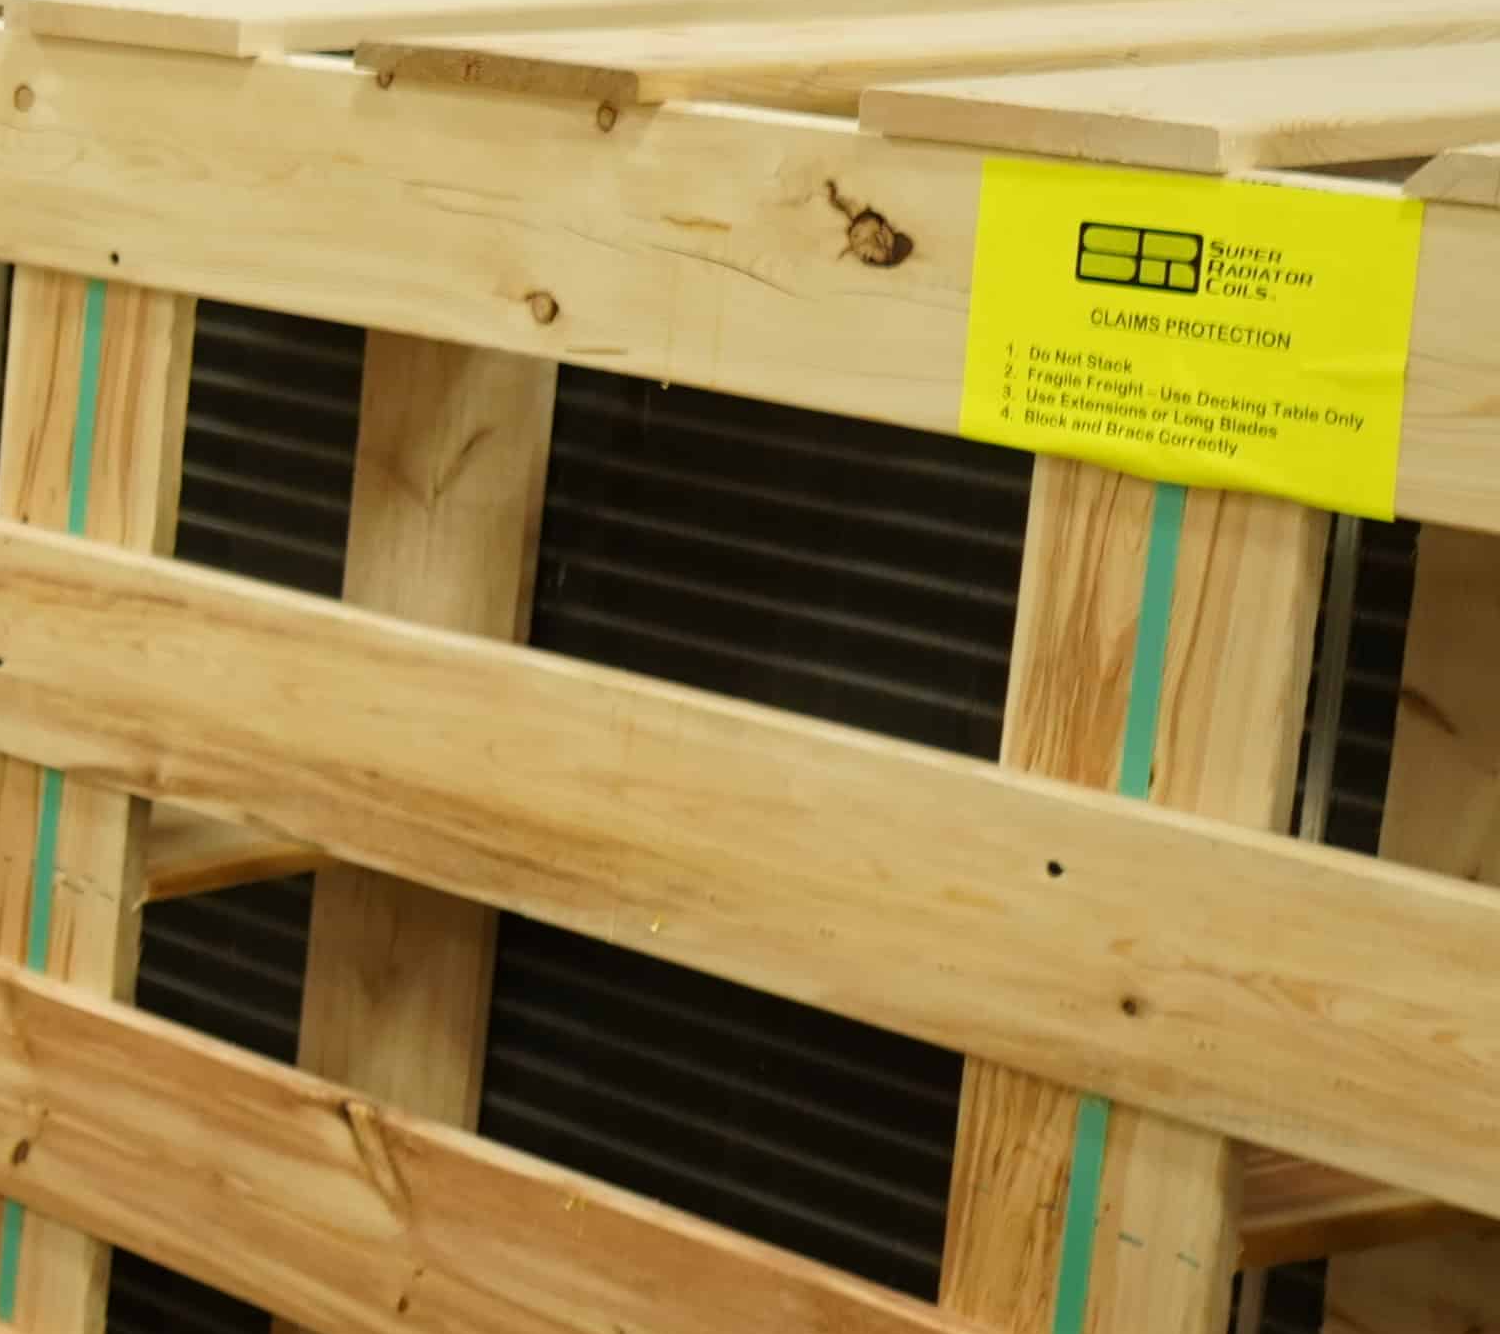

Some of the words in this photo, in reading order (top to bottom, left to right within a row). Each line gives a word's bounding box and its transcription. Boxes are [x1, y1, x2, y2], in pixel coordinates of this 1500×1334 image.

[1090, 306, 1160, 334] CLAIMS
[1166, 317, 1292, 351] PROTECTION
[1029, 346, 1050, 363] Do
[1055, 349, 1082, 367] Not
[1087, 354, 1132, 374] Stack
[1026, 387, 1056, 404] Use
[1060, 392, 1148, 421] Extensions
[1151, 410, 1169, 422] or
[1174, 410, 1215, 433] Long
[1220, 416, 1279, 439] Blades
[1027, 367, 1082, 389] Fragile
[1087, 375, 1143, 398] Freight
[1160, 386, 1191, 405] Use
[1197, 390, 1267, 418] Decking
[1273, 402, 1320, 423] Table
[1324, 408, 1365, 433] Only
[1024, 408, 1068, 428] Block
[1072, 418, 1103, 434] and
[1106, 421, 1155, 443] Brace
[1159, 429, 1239, 457] Correctly
